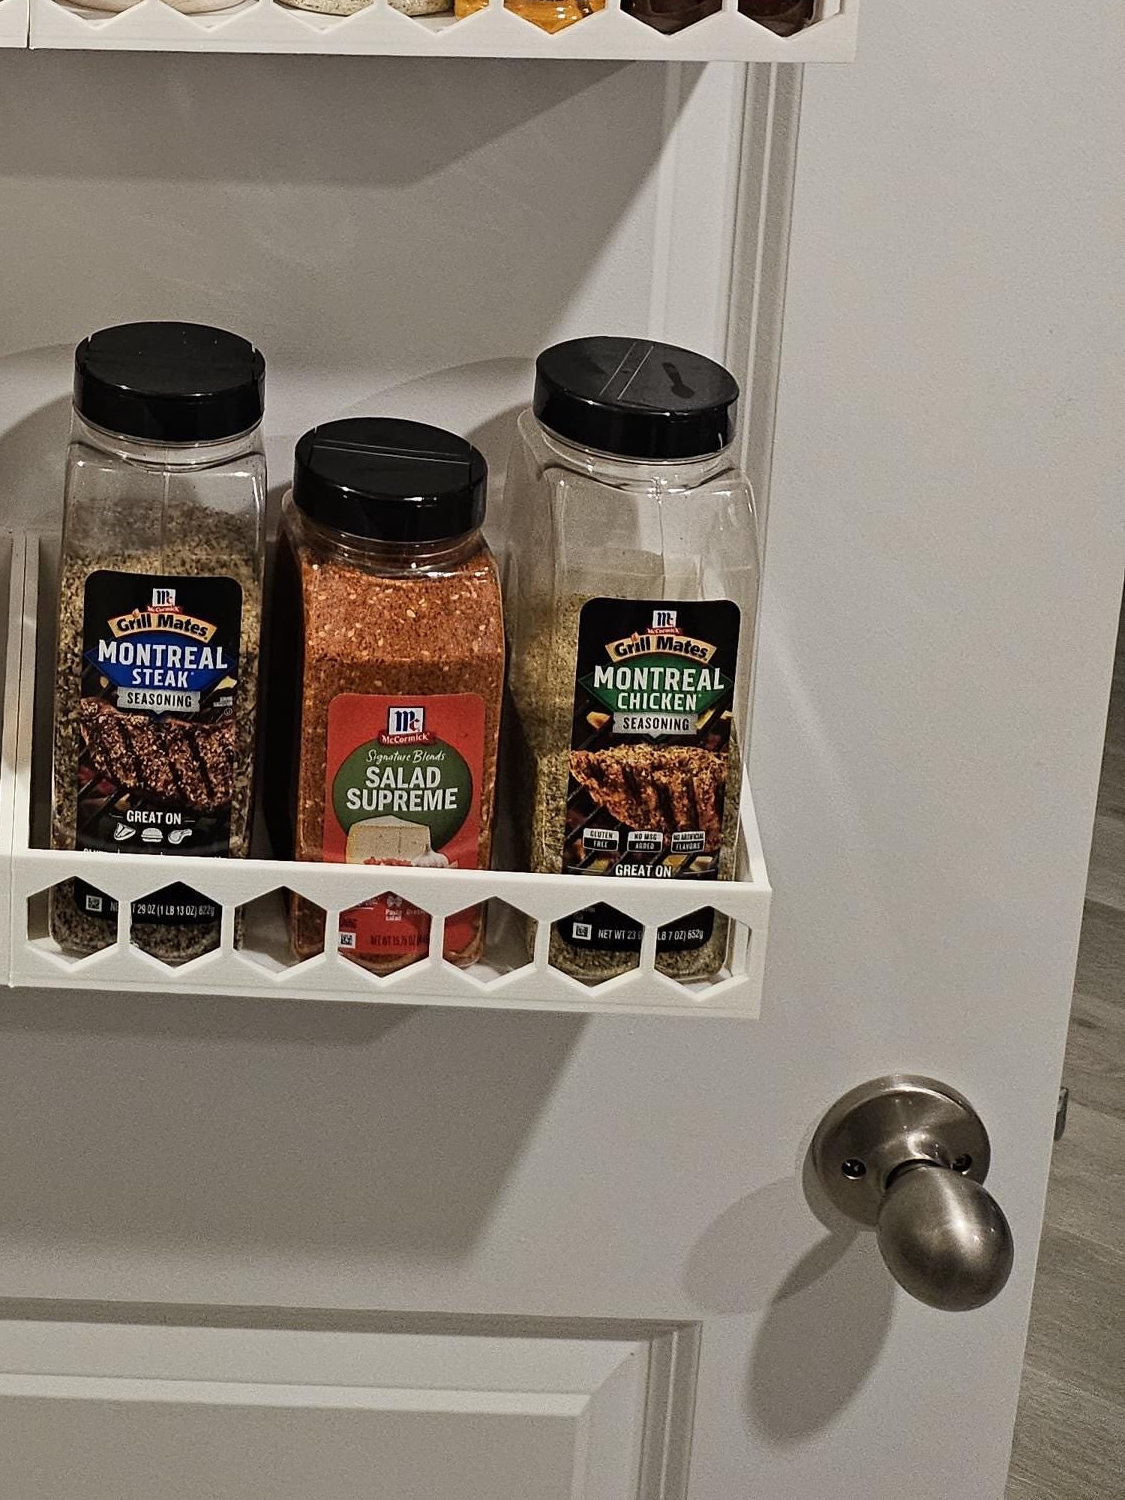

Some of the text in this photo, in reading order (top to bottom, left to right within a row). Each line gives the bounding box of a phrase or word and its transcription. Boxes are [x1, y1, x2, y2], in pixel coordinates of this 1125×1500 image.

[117, 615, 208, 637] Grill Mates
[98, 640, 227, 669] MONTREAL
[614, 636, 708, 659] Grill Mates
[132, 669, 188, 687] STEAK
[593, 665, 724, 690] MONTREAL
[127, 693, 192, 708] SEASONING
[617, 693, 697, 711] CHICKEN
[623, 716, 689, 731] SEASONING
[381, 734, 428, 744] McCormick
[366, 750, 445, 762] Signature Blends
[365, 767, 441, 788] SALAD
[347, 788, 458, 812] SUPREME
[126, 811, 181, 824] GREAT ON
[590, 830, 613, 839] GLUTEN
[635, 842, 655, 850] ADDED
[615, 865, 671, 877] GREAT ON
[598, 929, 613, 939] NET
